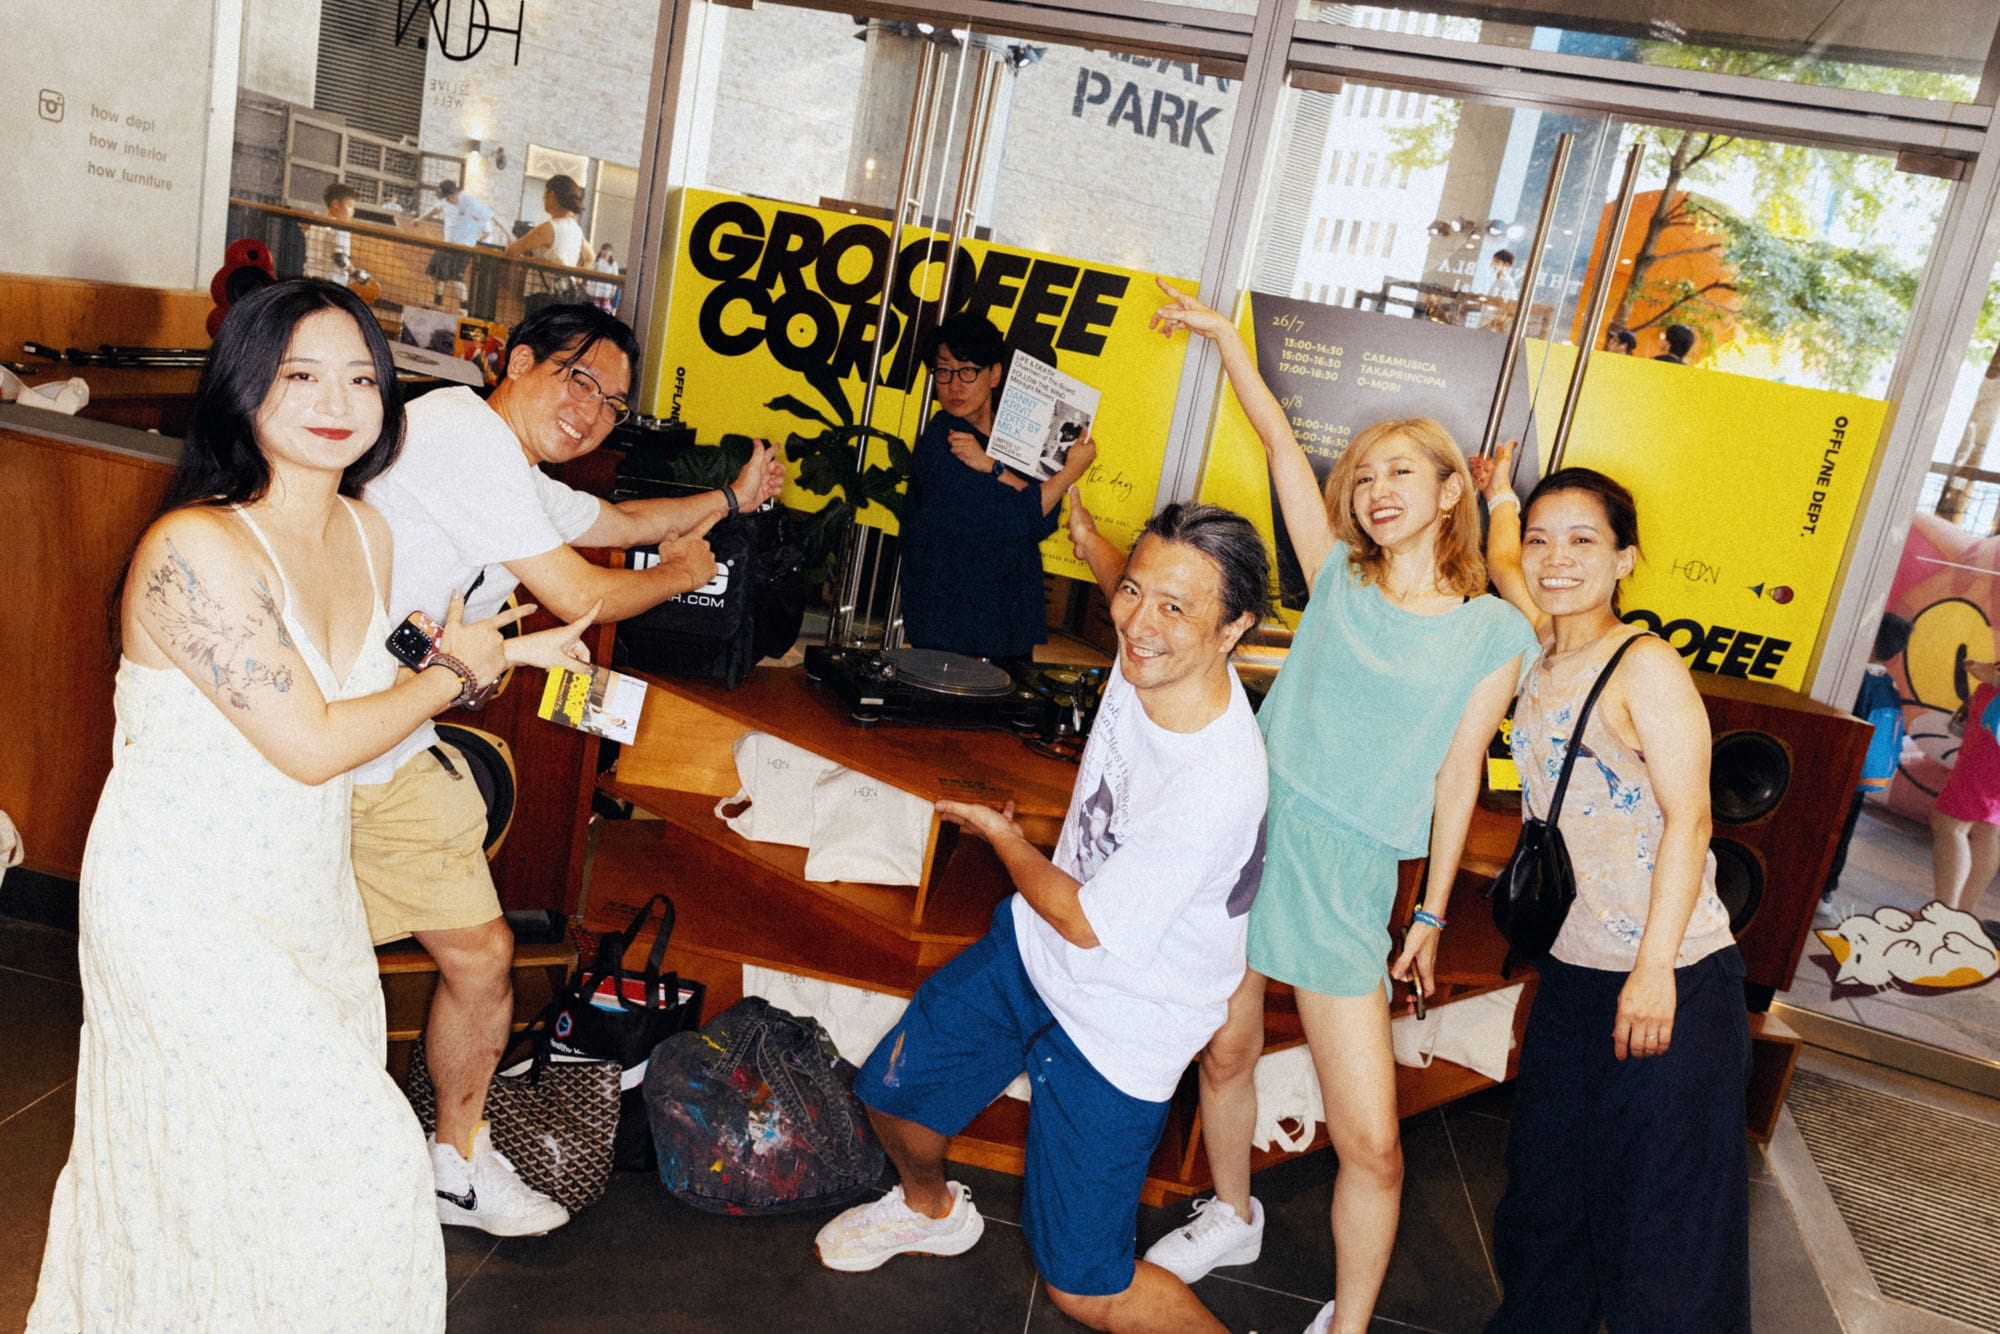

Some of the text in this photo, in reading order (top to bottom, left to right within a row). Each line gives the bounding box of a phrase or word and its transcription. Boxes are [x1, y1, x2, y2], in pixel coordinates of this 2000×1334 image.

[1072, 67, 1223, 155] PARK
[1271, 313, 1305, 333] 26/7
[1284, 337, 1344, 356] 13:00-14:30
[1281, 350, 1342, 369] 15:00-16:30
[1362, 351, 1438, 373] CASAMUSICA
[1279, 362, 1339, 382] 17:00-18:30
[1006, 387, 1039, 408] DANNY
[1281, 393, 1304, 411] 9/8
[1000, 410, 1041, 434] EDITS BY
[1292, 416, 1351, 436] 13:00-14:30
[1292, 429, 1349, 448] 5:00-16:30
[1800, 490, 1827, 538] DEPT.
